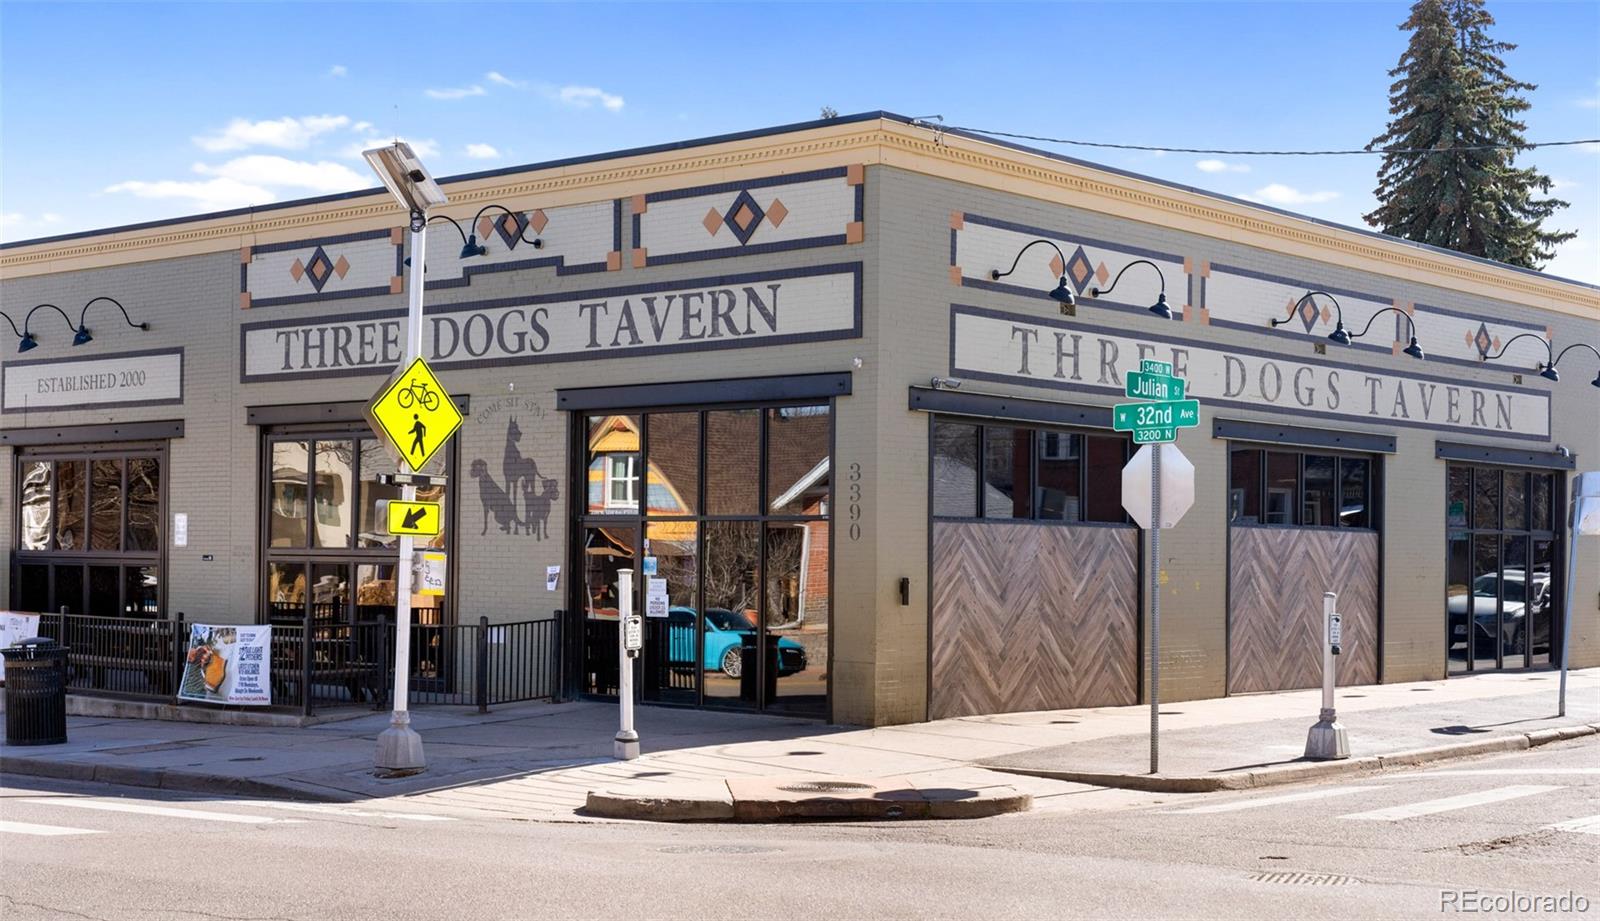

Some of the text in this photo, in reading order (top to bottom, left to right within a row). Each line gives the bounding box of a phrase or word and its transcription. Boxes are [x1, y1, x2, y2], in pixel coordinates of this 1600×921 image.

[276, 284, 782, 370] THREE DOGS TAVERN
[1144, 362, 1163, 374] 3400
[37, 370, 146, 394] ESTABLISHED 2000
[1132, 377, 1168, 398] Julian
[1223, 355, 1340, 410] DOGS
[1364, 375, 1513, 430] TAVERN
[1119, 406, 1194, 426] W 32nd Ave
[1138, 430, 1172, 441] 3200 N
[849, 462, 861, 542] 3390
